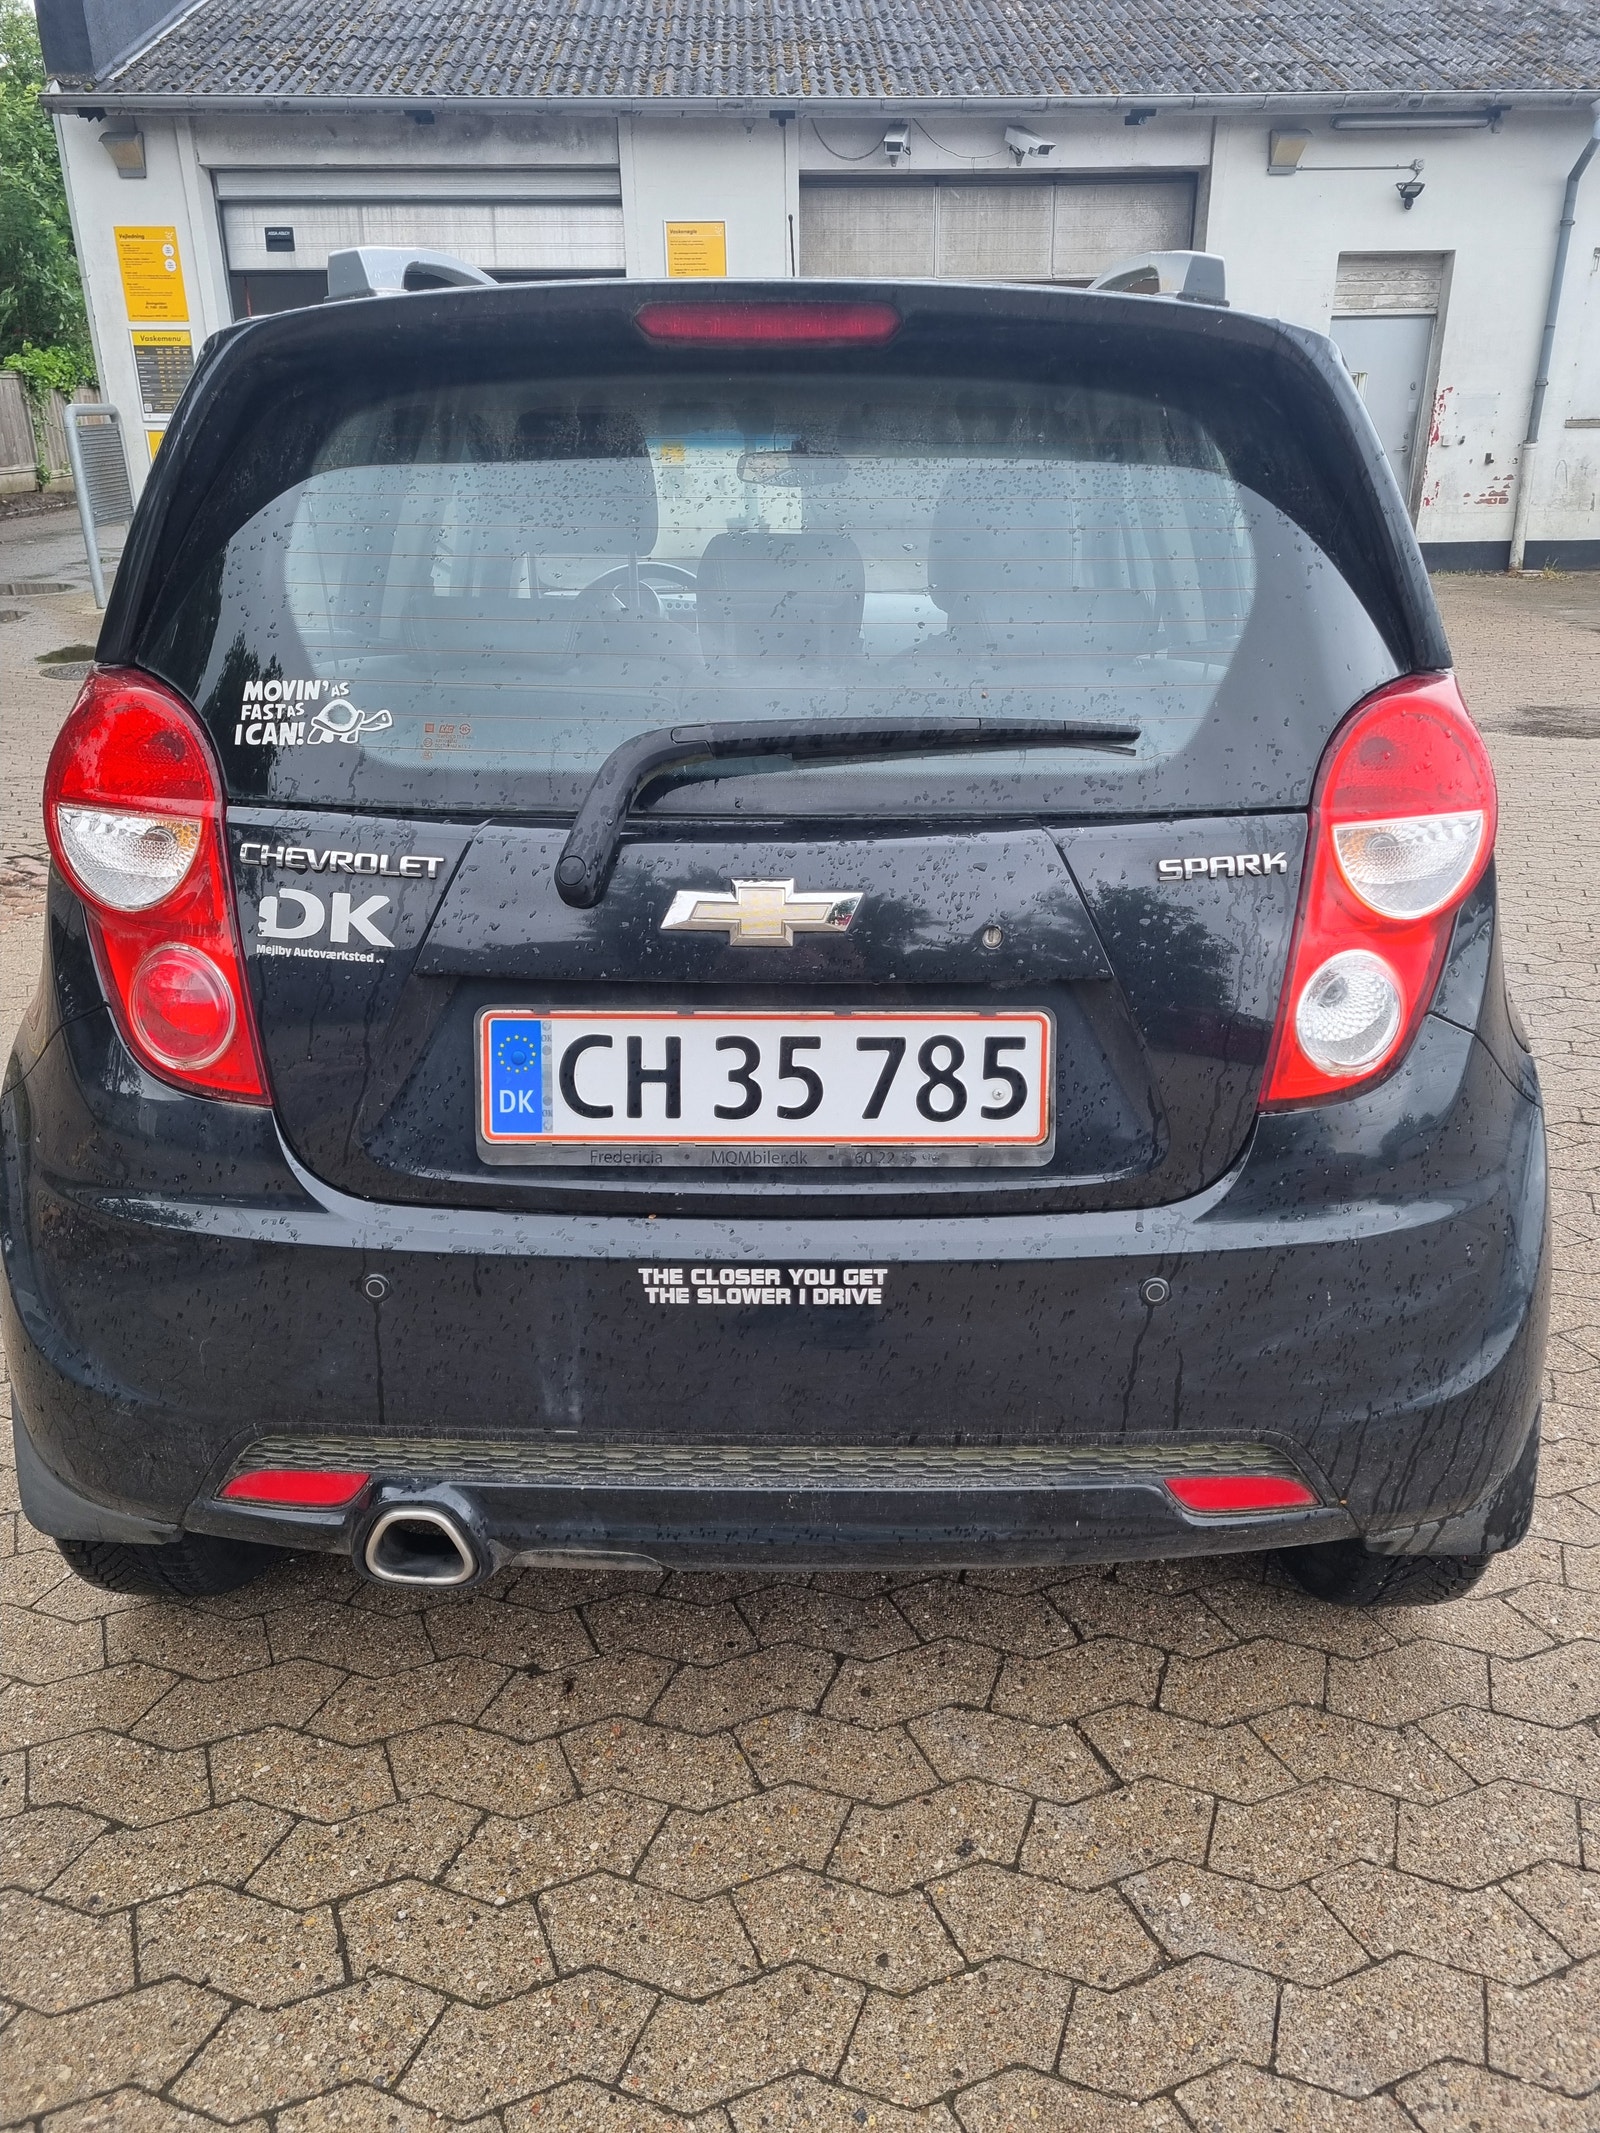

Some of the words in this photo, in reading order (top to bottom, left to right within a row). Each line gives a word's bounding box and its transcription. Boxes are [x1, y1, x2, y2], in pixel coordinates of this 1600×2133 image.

[242, 679, 329, 702] MOVIN'
[330, 681, 350, 698] AS
[240, 703, 286, 721] FAST
[286, 702, 305, 718] AS
[234, 723, 244, 746] I
[244, 721, 306, 746] CAN!
[239, 842, 446, 879] CHEVROLET
[1158, 851, 1289, 882] SPARK
[257, 887, 396, 948] DK
[256, 944, 292, 959] Mejlby
[558, 1032, 683, 1120] CH
[713, 1034, 825, 1121] 35
[855, 1033, 1029, 1123] 785
[499, 1089, 535, 1113] DK
[590, 1150, 664, 1165] Fredericia
[711, 1150, 808, 1165] MQMbiler.dk
[855, 1151, 873, 1165] 60
[638, 1268, 683, 1286] THE
[691, 1268, 781, 1286] CLOSER
[788, 1268, 836, 1286] YOU
[843, 1268, 889, 1286] GET
[644, 1287, 690, 1305] THE
[697, 1287, 791, 1305] SLOWER
[799, 1288, 806, 1306] I
[812, 1288, 882, 1306] DRIVE
